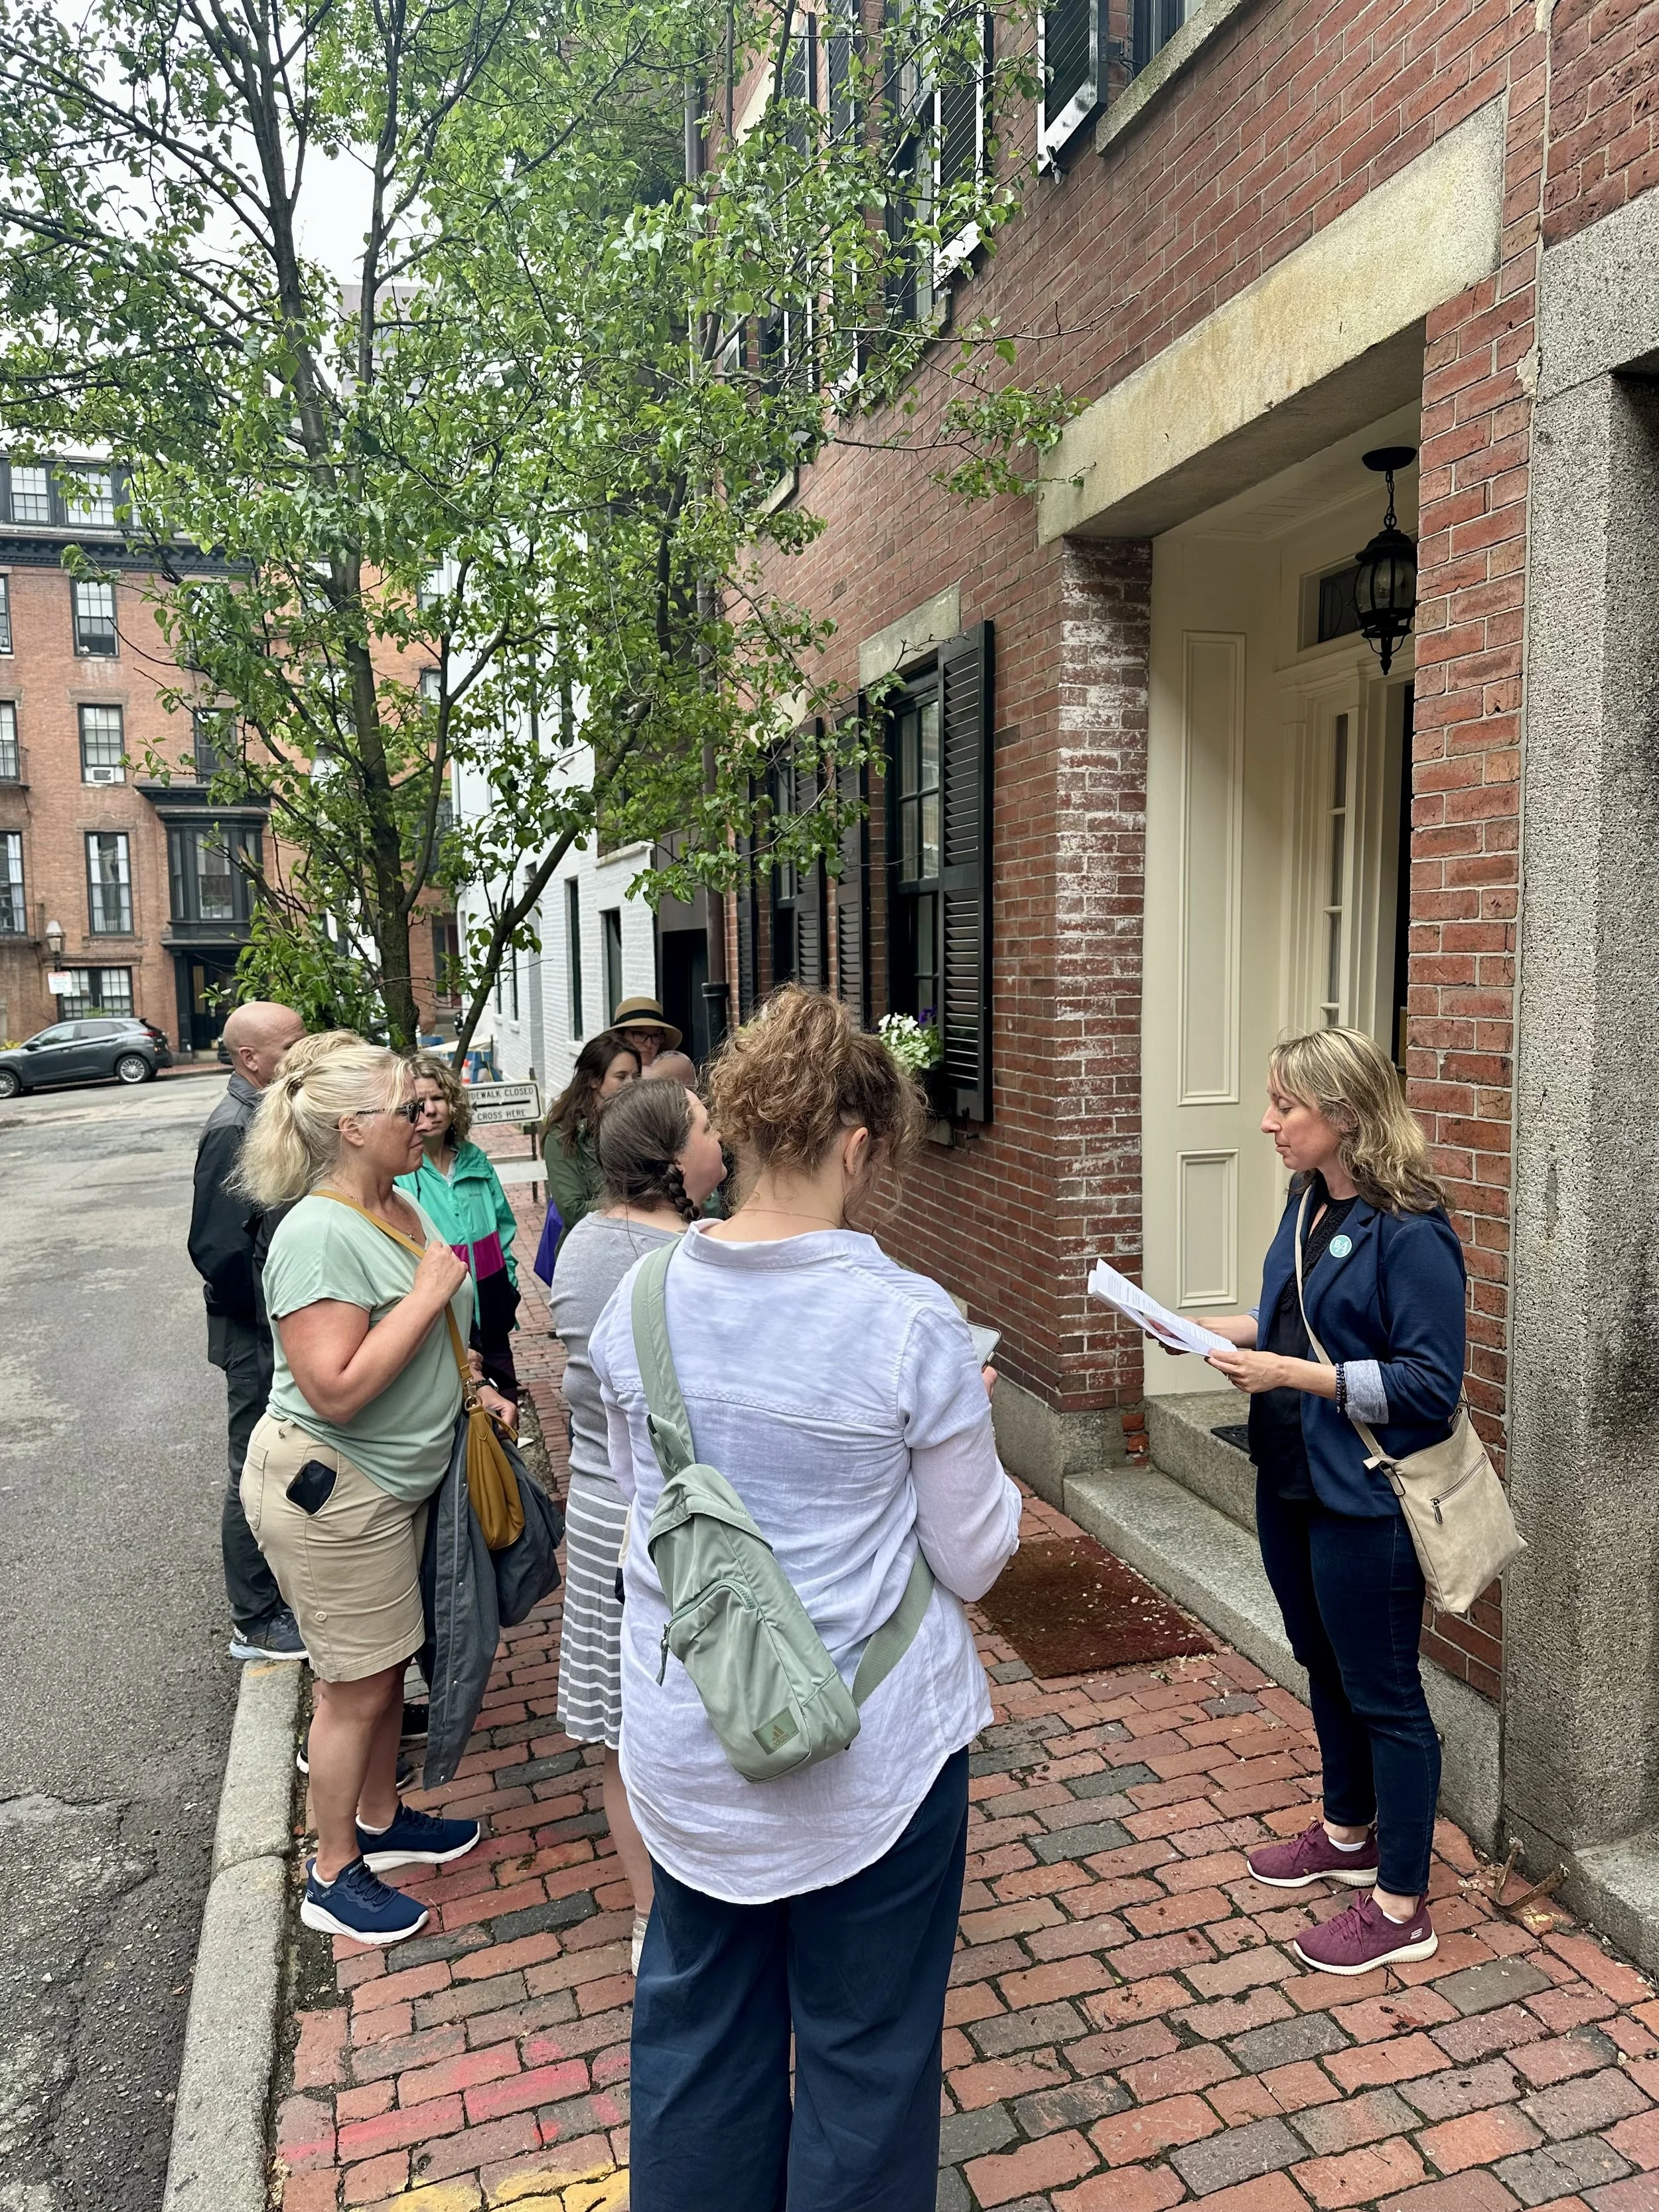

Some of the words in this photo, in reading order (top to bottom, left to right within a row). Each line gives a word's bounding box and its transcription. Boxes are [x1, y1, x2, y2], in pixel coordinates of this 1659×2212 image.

[504, 1087, 534, 1096] CLOSED
[477, 1111, 503, 1121] CROSS
[506, 1109, 526, 1118] HERE
[772, 1732, 790, 1748] adidas
